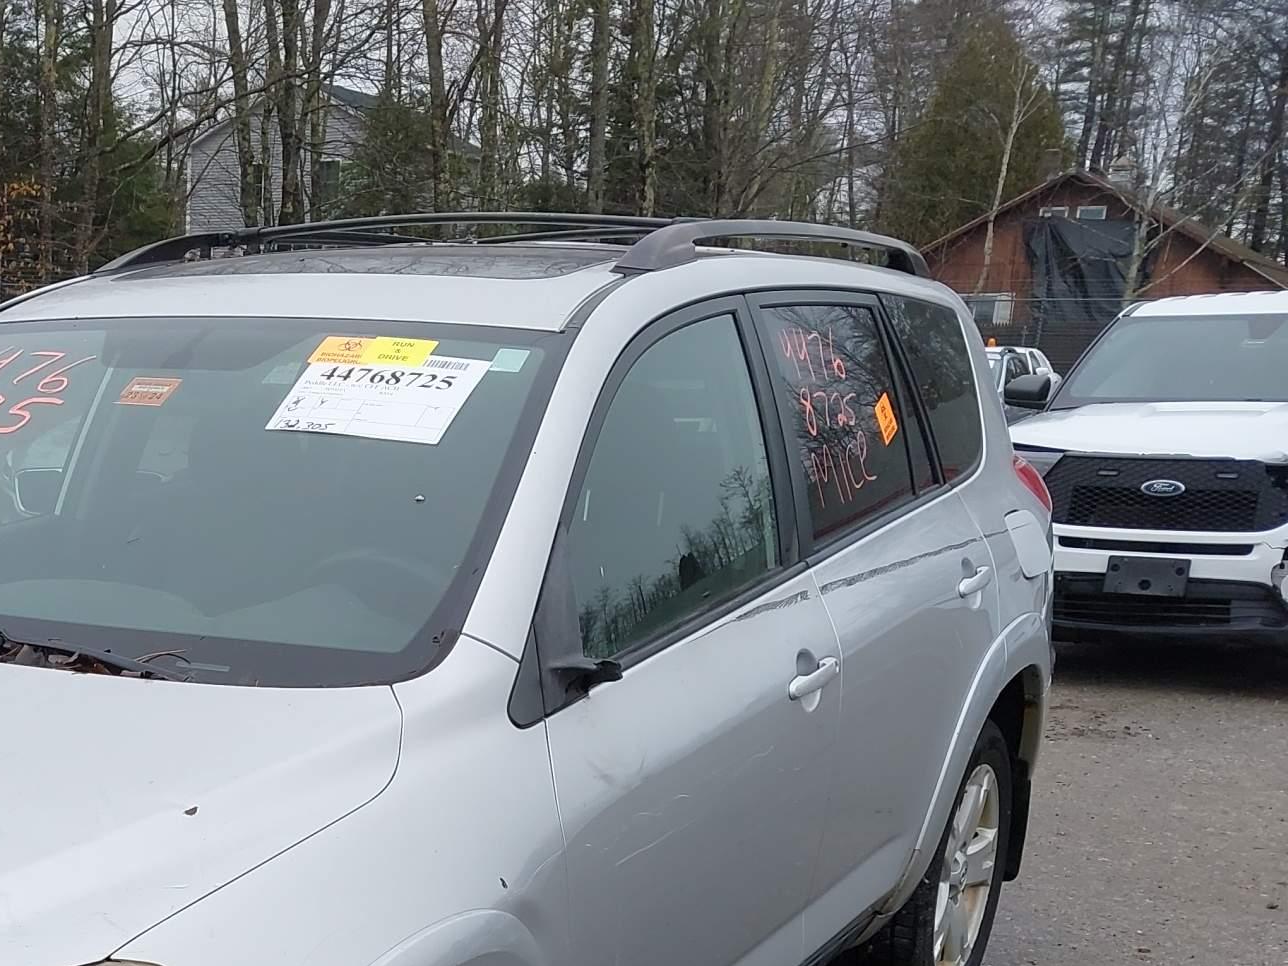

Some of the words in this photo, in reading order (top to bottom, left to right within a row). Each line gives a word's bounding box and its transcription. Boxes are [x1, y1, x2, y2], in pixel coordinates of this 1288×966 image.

[320, 366, 458, 390] 44768725
[778, 327, 846, 381] 4476
[800, 387, 857, 436] 8725
